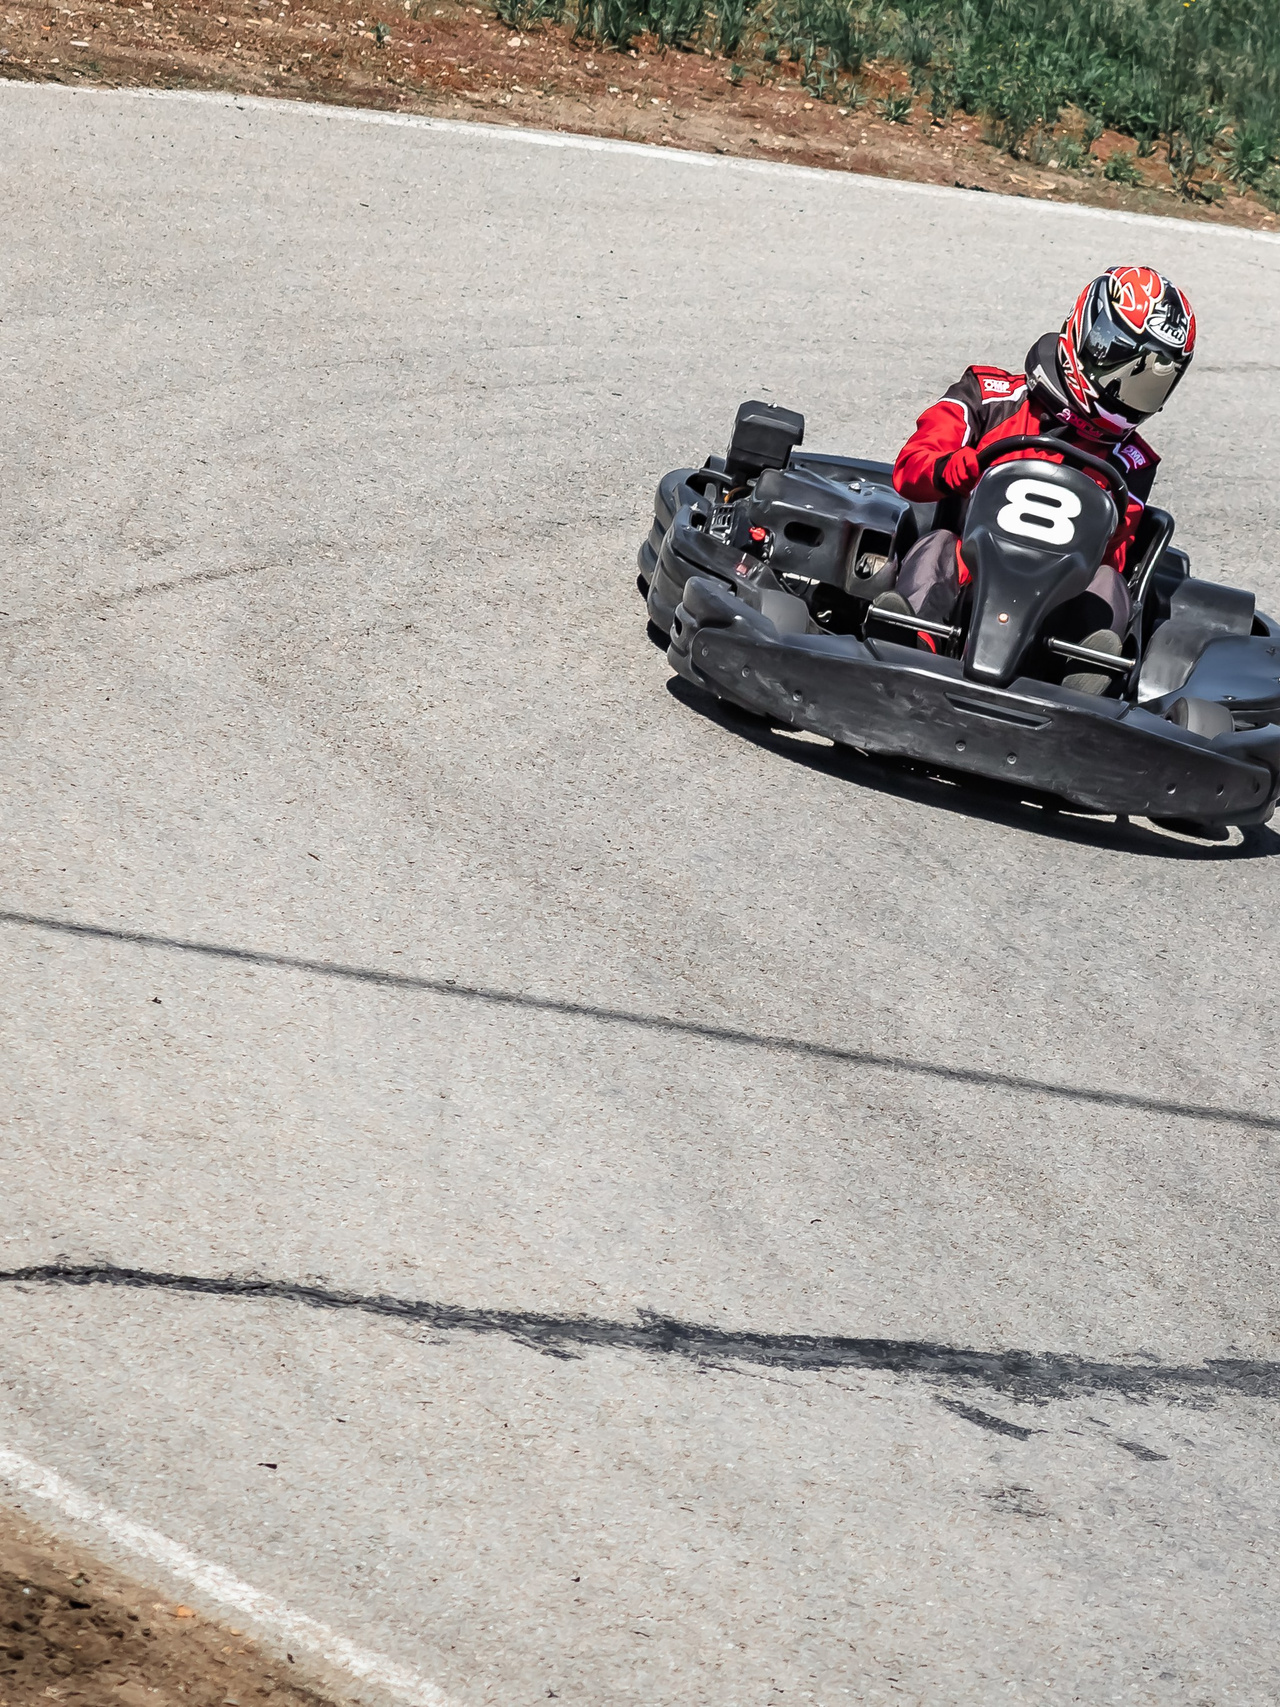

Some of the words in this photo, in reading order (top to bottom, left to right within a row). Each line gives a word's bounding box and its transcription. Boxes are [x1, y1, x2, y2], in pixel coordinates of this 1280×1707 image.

[982, 379, 1011, 393] OMP
[1121, 444, 1146, 469] OMP
[997, 479, 1082, 545] 8
